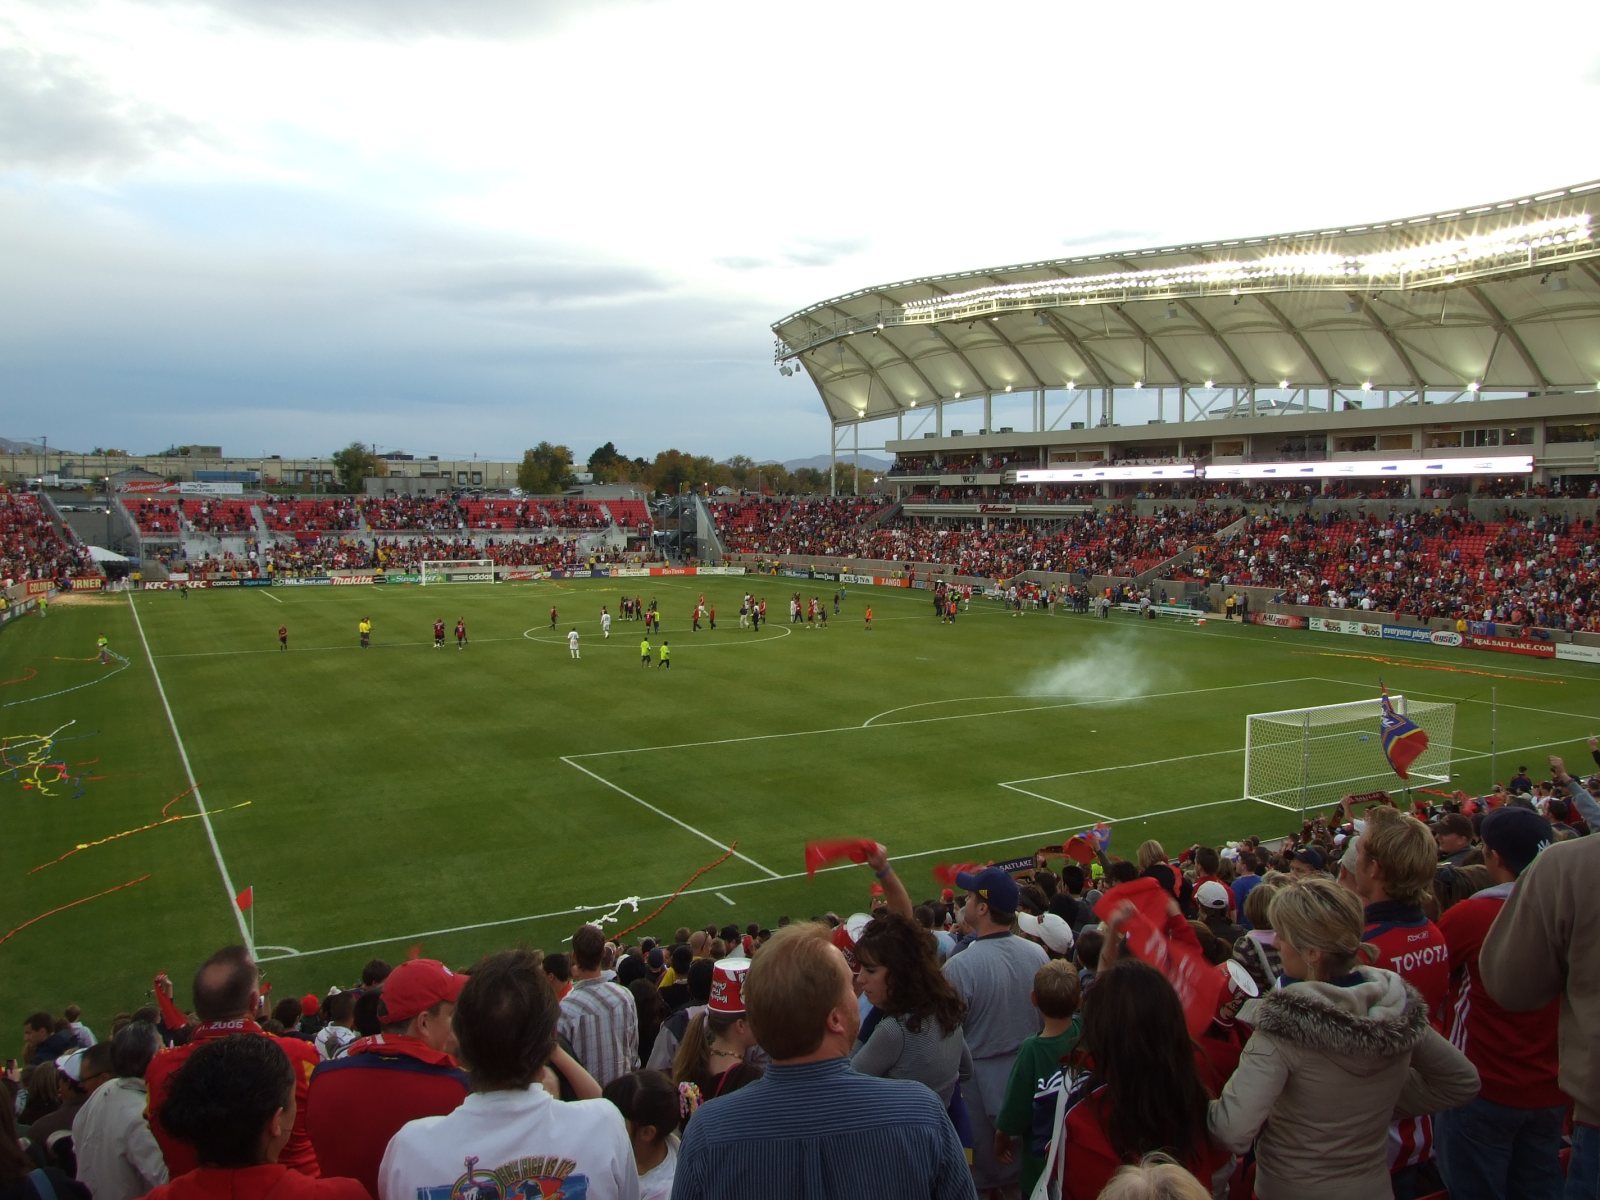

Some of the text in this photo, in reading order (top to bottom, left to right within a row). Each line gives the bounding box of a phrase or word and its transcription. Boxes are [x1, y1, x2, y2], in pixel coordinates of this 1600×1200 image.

[30, 581, 55, 593] COLONE
[144, 581, 169, 590] KFC
[185, 580, 208, 588] KFC
[881, 578, 901, 587] XANGO
[1383, 627, 1412, 637] everyone
[1412, 630, 1432, 640] plays!
[1473, 638, 1492, 646] REAL
[1492, 640, 1510, 648] SALT
[1510, 642, 1555, 653] LAKE.COM
[1390, 944, 1448, 973] TOYOTA
